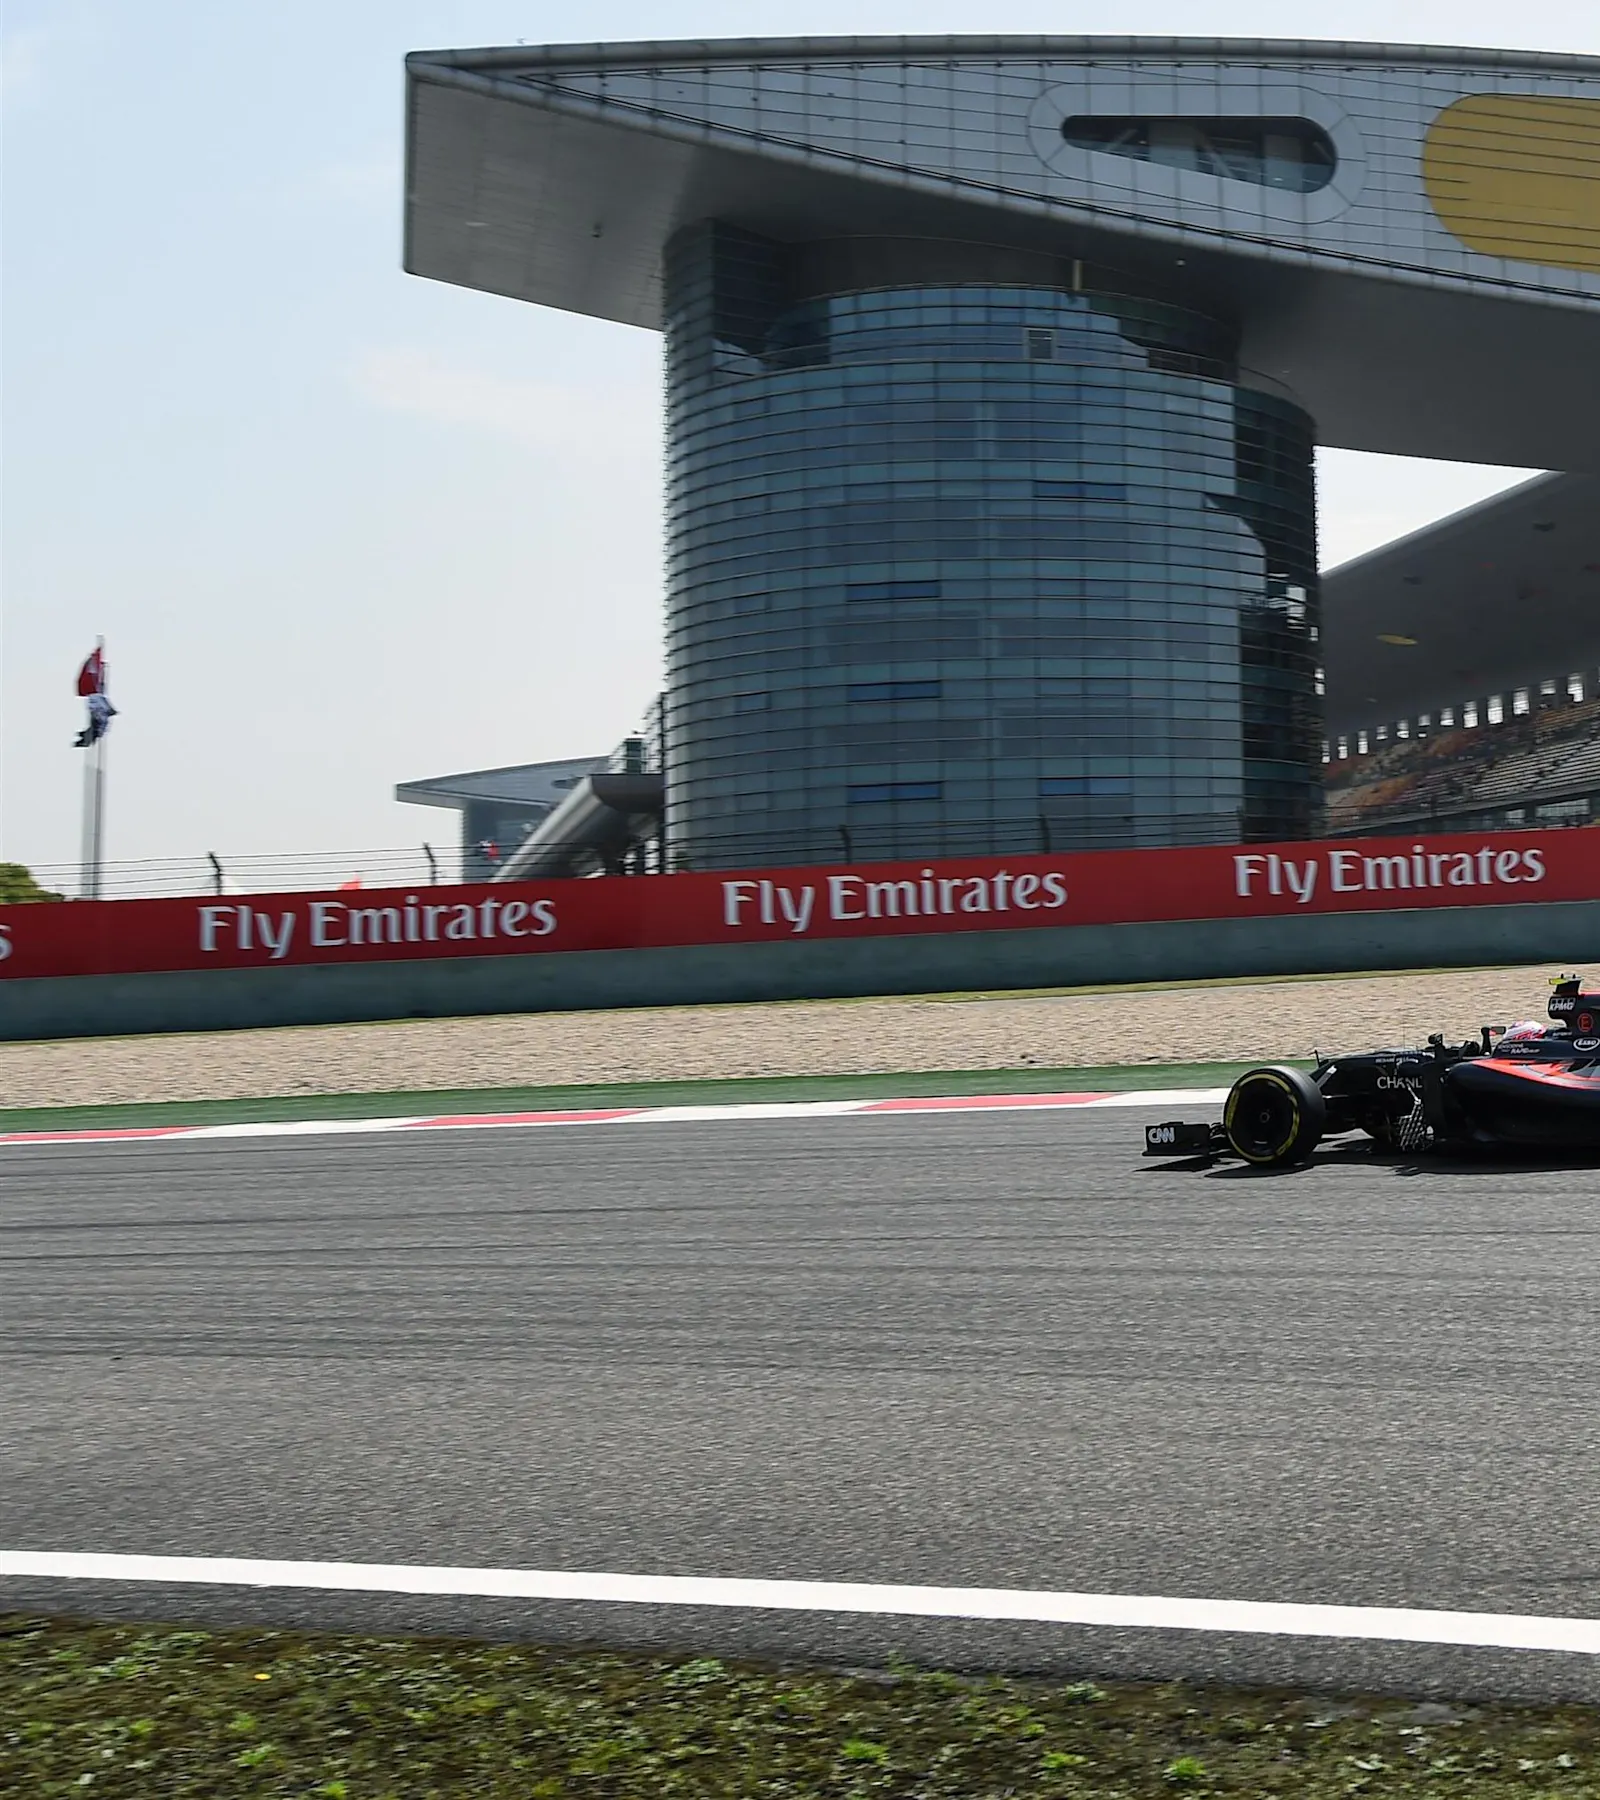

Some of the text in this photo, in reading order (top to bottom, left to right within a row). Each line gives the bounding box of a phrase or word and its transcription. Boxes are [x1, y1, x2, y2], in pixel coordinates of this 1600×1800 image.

[721, 868, 1068, 933] Fly Emirates
[1233, 844, 1546, 903] Fly Emirates
[198, 895, 557, 959] Fly Emirates
[1549, 1002, 1574, 1011] KPMG
[1148, 1127, 1175, 1143] CNN
